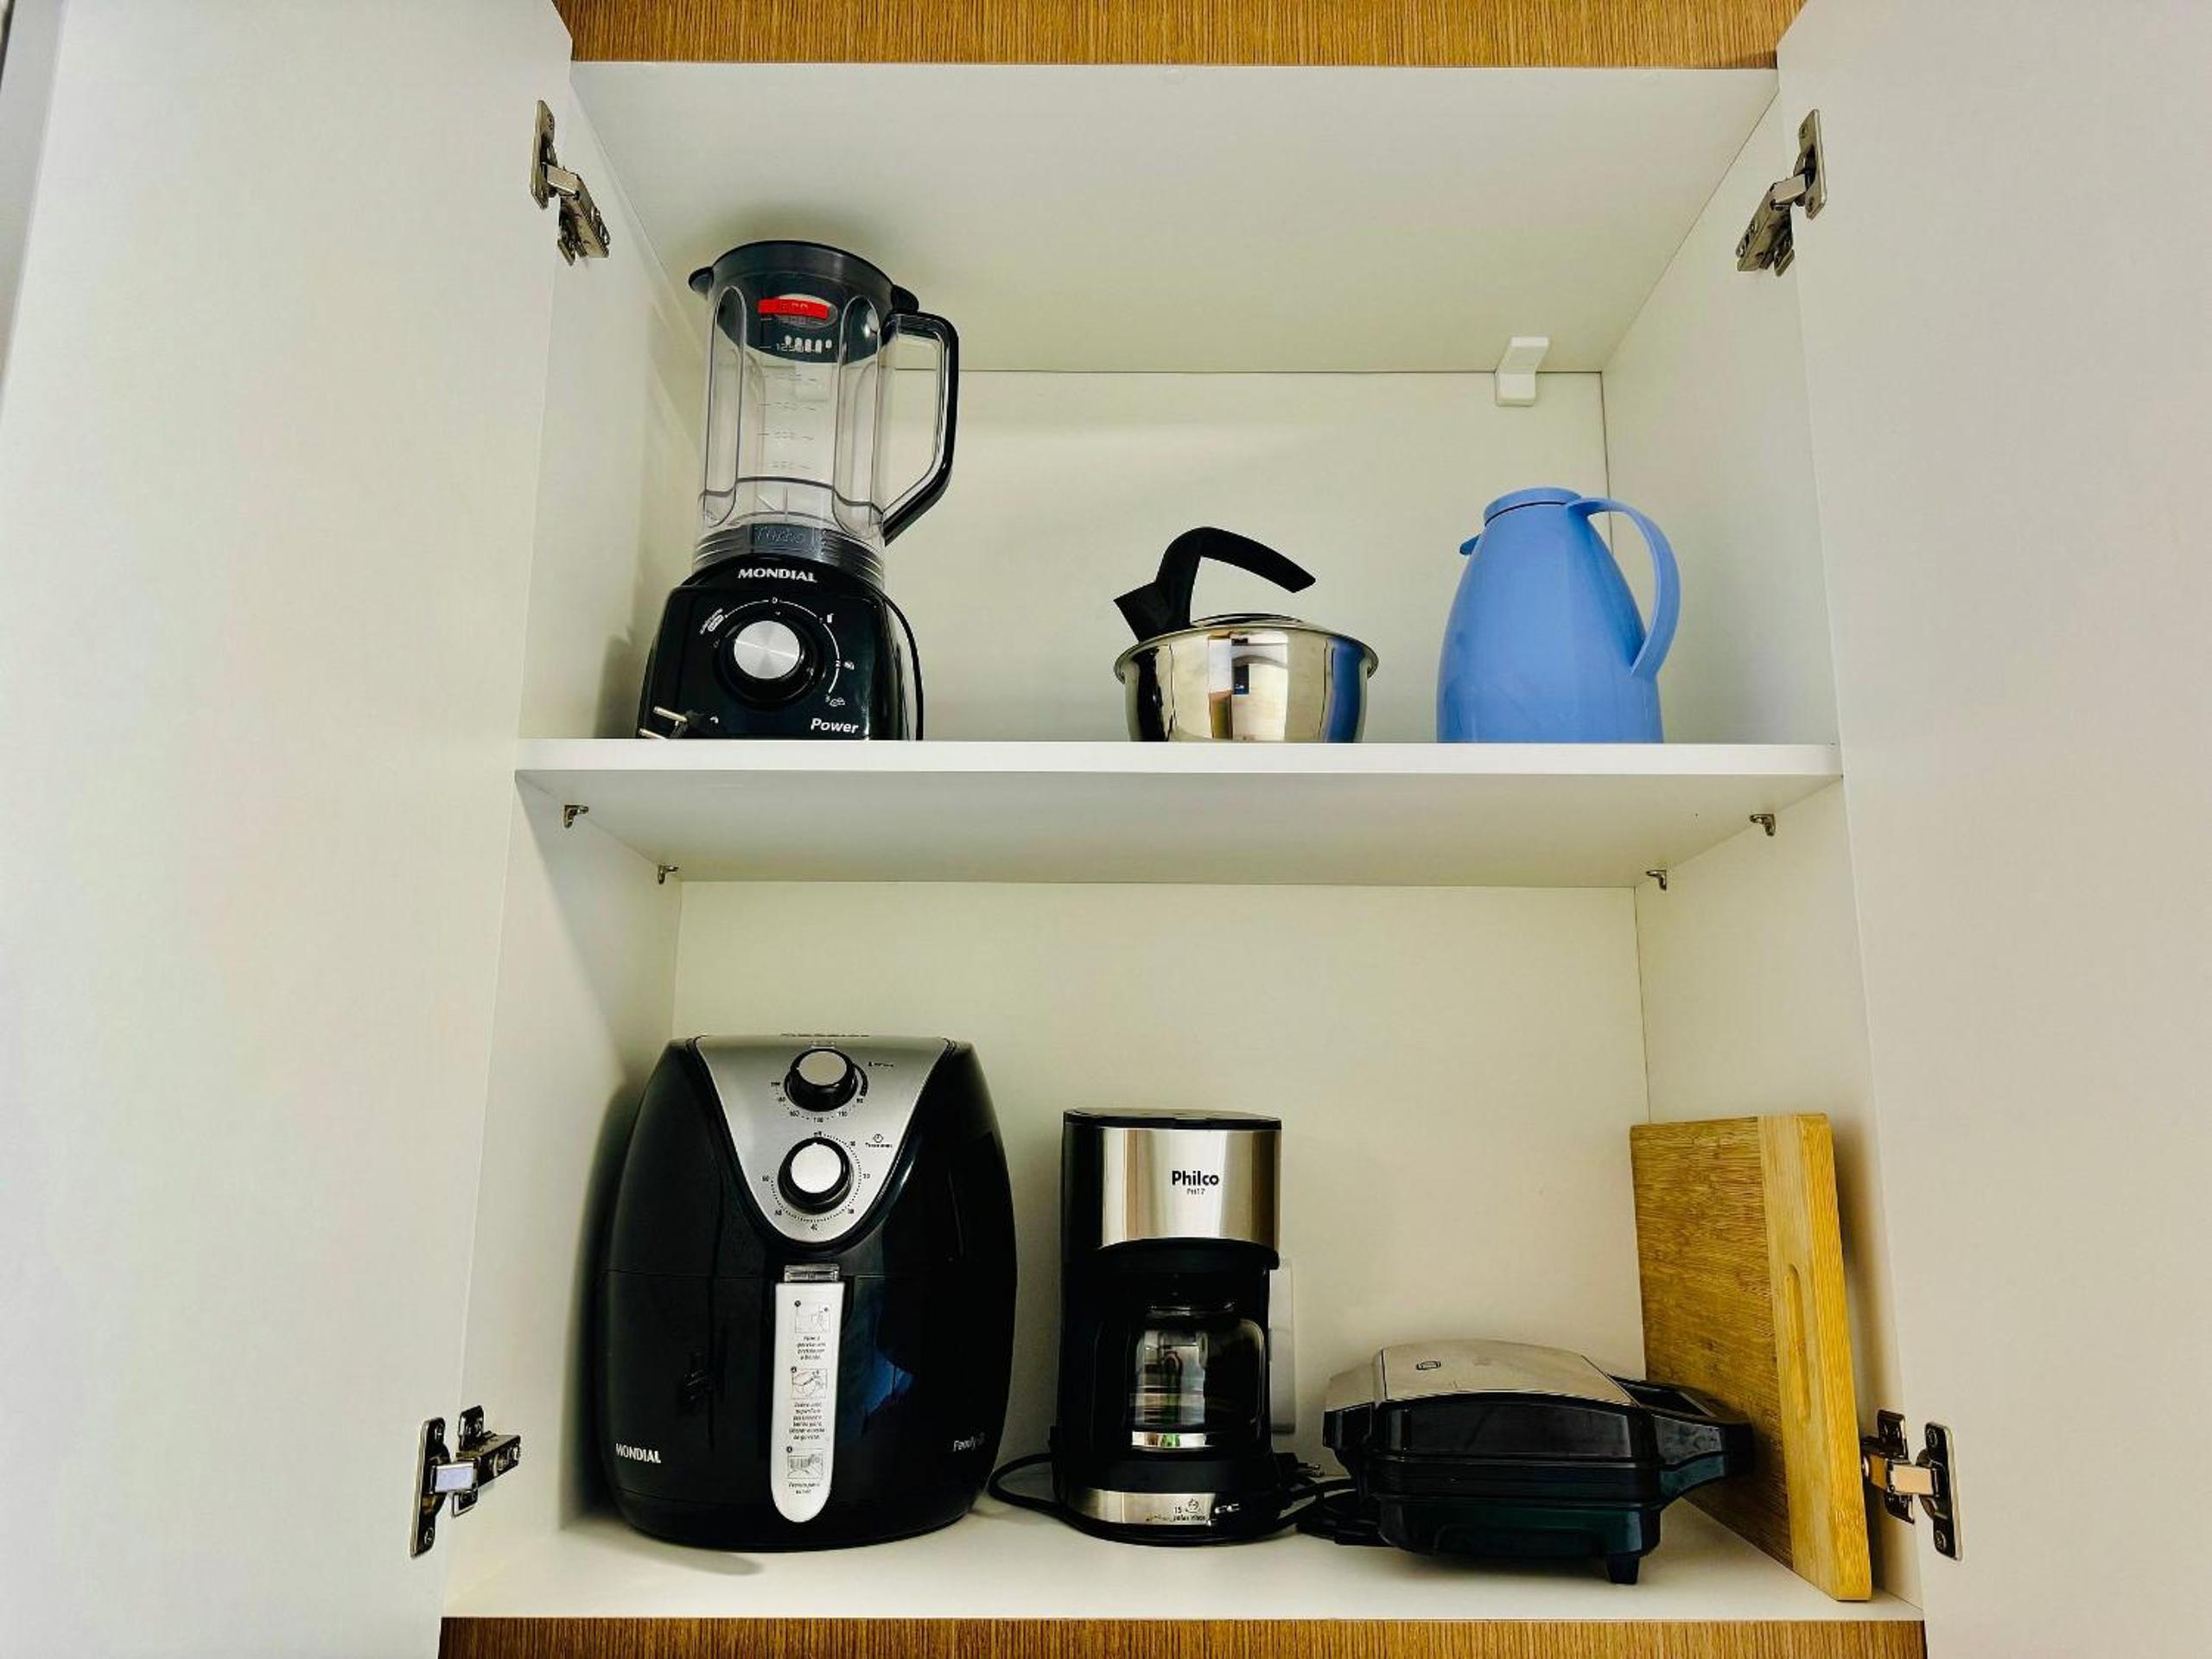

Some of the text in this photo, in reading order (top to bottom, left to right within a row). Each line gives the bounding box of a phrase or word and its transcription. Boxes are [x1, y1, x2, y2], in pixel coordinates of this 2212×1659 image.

[738, 567, 818, 583] MONDIAL
[810, 718, 859, 734] Power
[1172, 1170, 1219, 1185] Philco
[615, 1442, 662, 1464] MONDIAL
